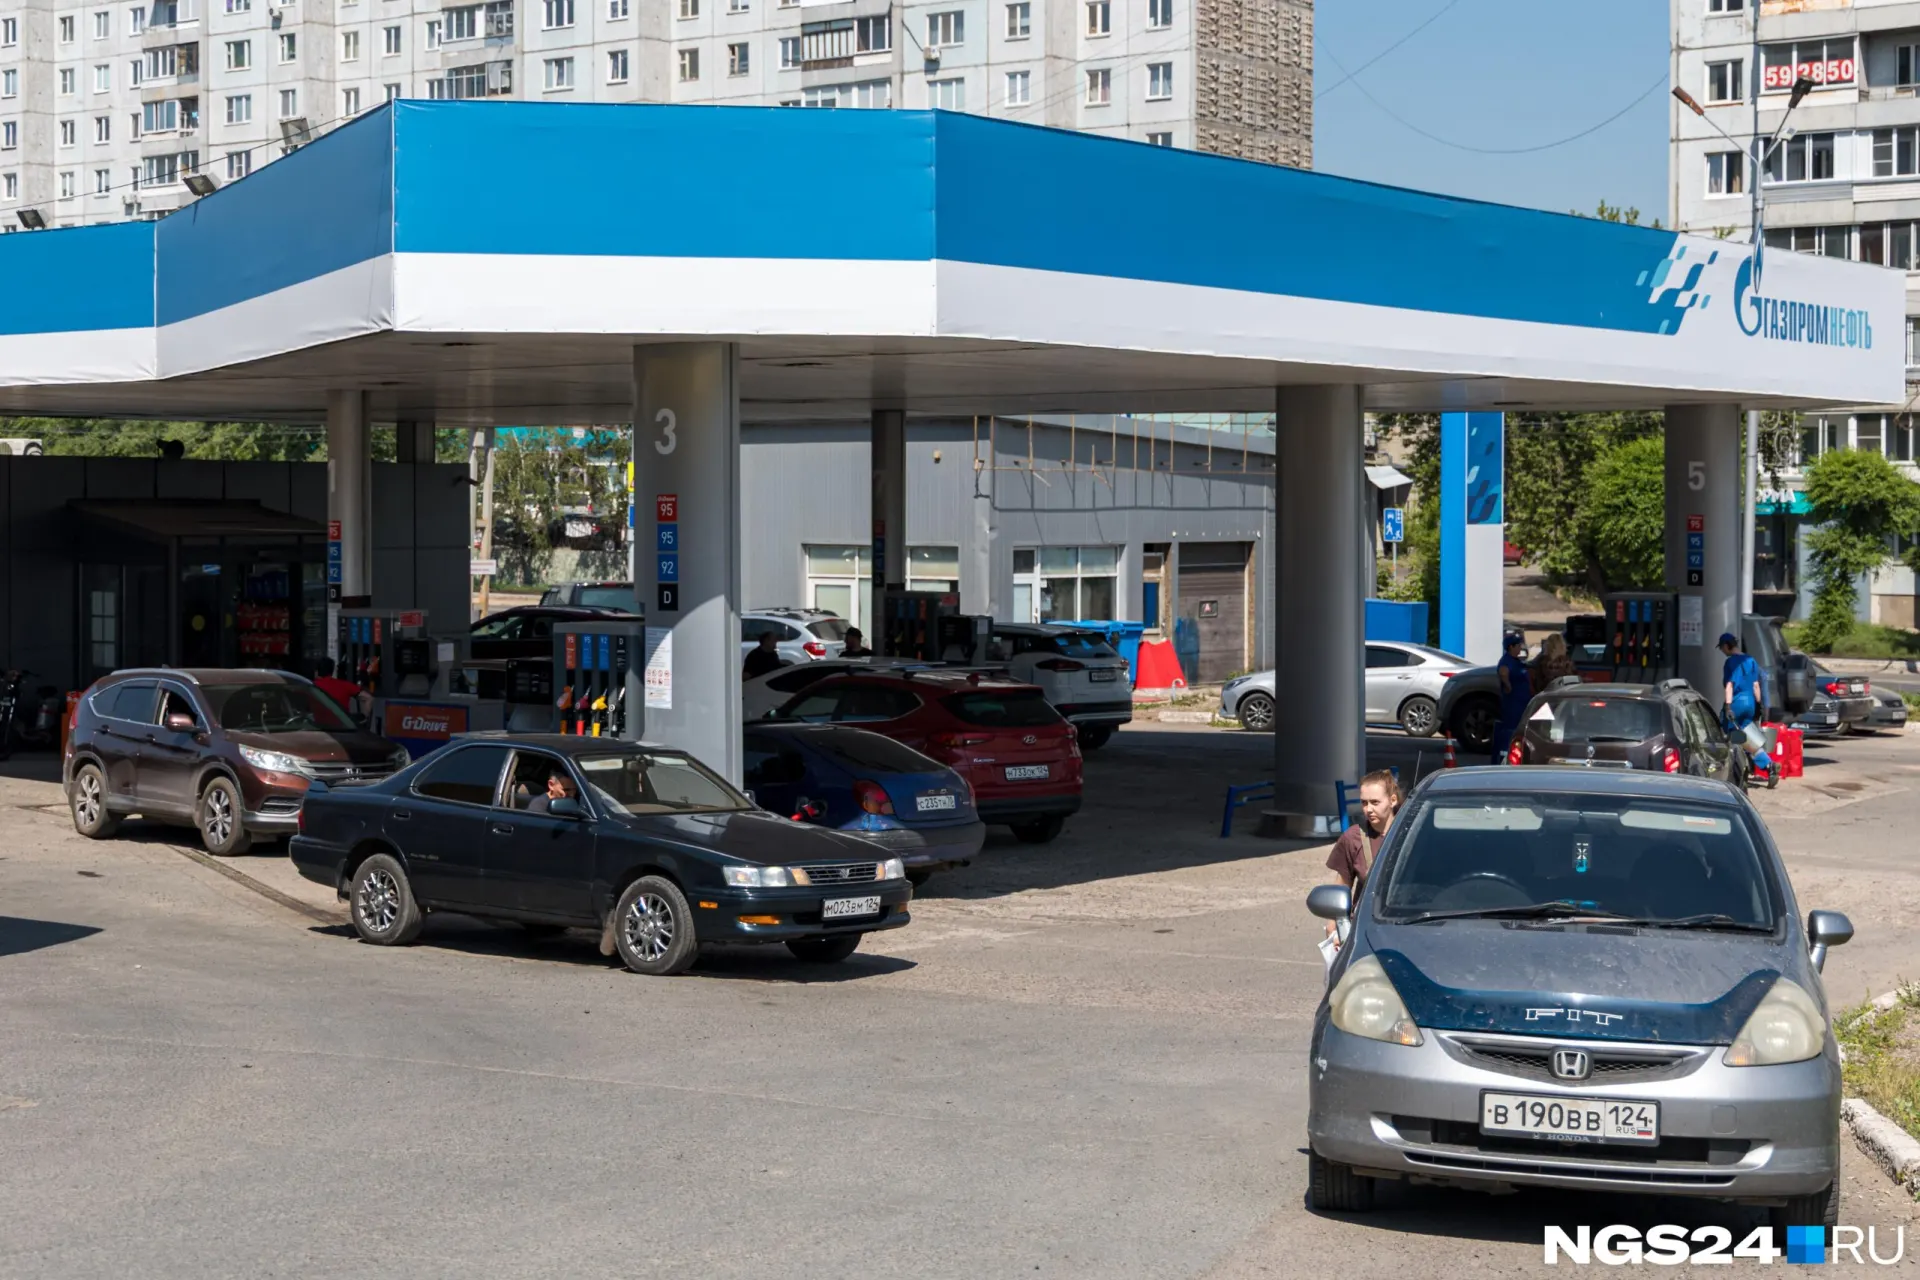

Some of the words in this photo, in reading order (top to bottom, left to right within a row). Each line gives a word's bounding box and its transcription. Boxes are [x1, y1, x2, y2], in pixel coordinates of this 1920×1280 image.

[1763, 297, 1872, 349] ГАЗПРОМНЕФТЬ
[654, 408, 677, 455] 3
[1688, 461, 1706, 491] 5
[660, 503, 673, 517] 95
[1690, 518, 1701, 528] 95
[661, 531, 674, 545] 95
[1690, 536, 1701, 546] 95
[1690, 554, 1701, 564] 92
[661, 561, 674, 575] 92
[1691, 573, 1699, 583] D
[663, 591, 672, 604] D
[1525, 1009, 1623, 1026] FIT
[1608, 1106, 1648, 1127] 124
[1616, 1126, 1636, 1135] RUS
[1547, 1134, 1590, 1142] HONDA
